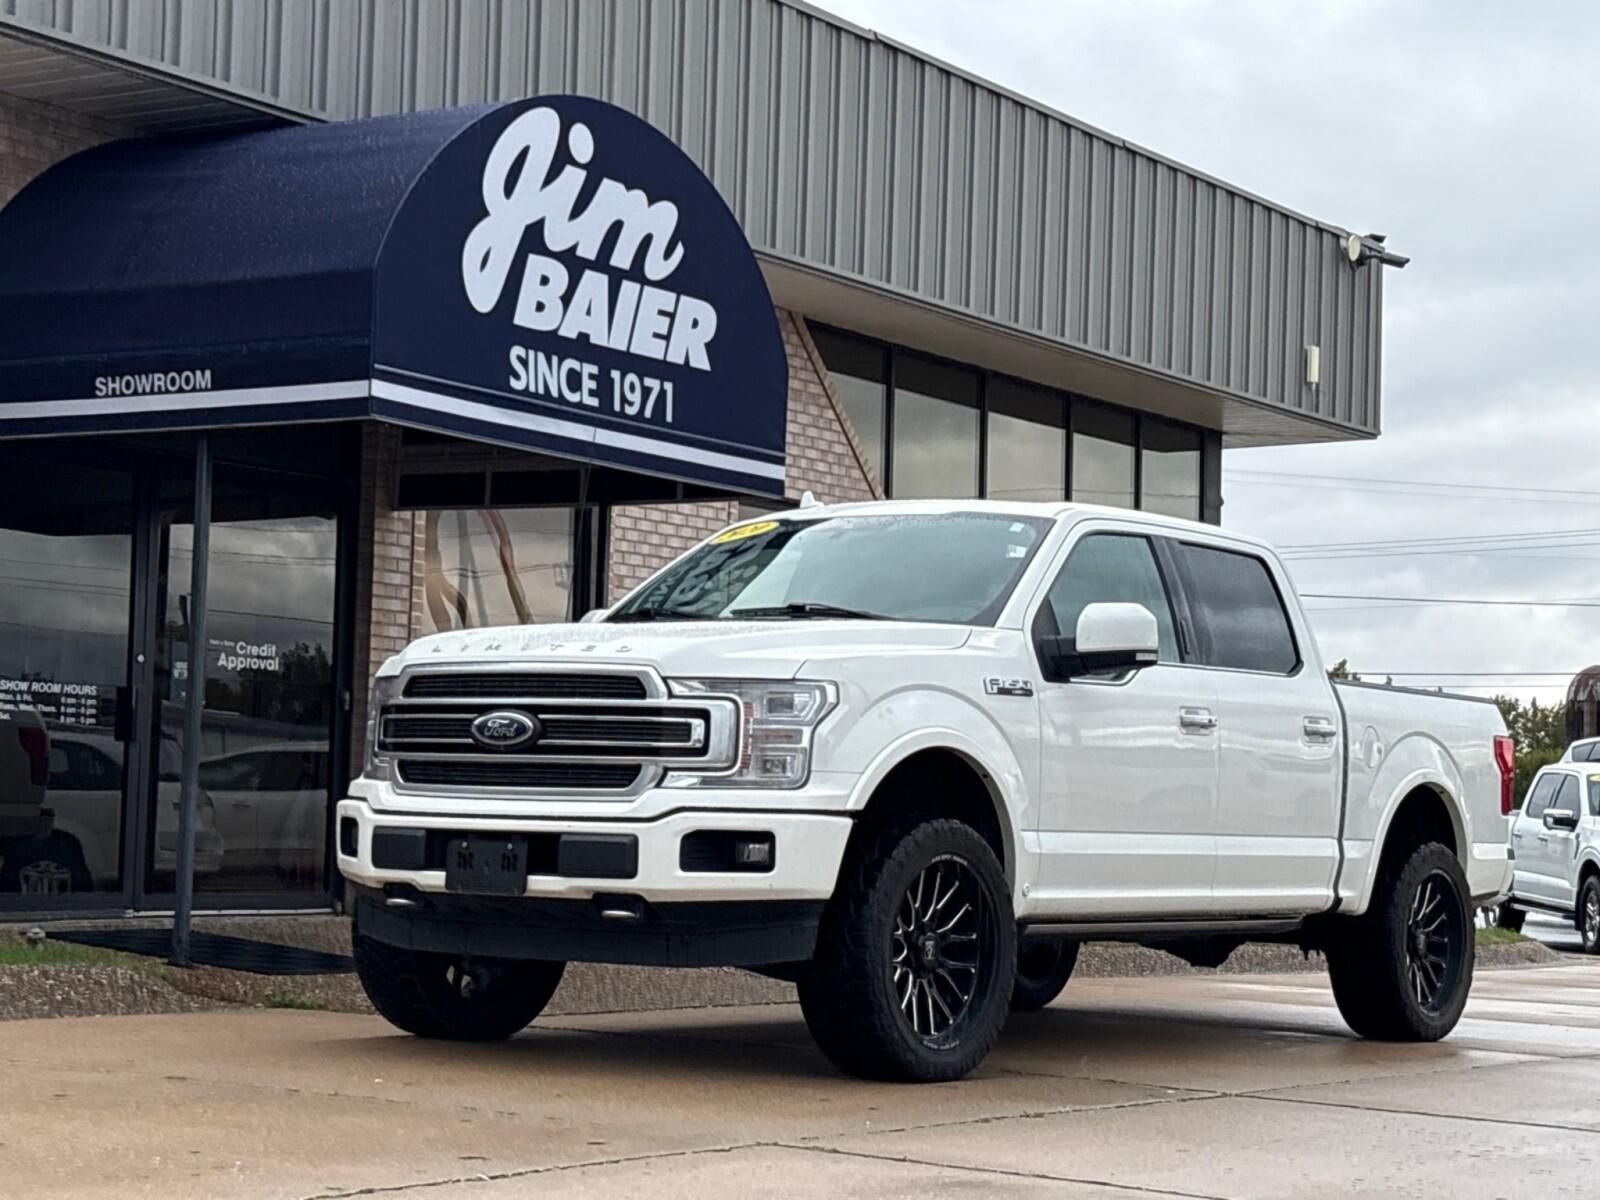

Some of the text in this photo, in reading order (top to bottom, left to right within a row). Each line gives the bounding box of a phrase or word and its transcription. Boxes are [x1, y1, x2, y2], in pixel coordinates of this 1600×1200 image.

[462, 106, 685, 314] Jim
[513, 253, 718, 371] BAIER
[95, 369, 213, 396] SHOWROOM
[509, 345, 674, 423] SINCE 1971
[236, 641, 277, 657] Credit
[217, 652, 280, 671] Approval
[0, 680, 98, 695] SHOW ROOM HOURS
[483, 718, 518, 737] Ford
